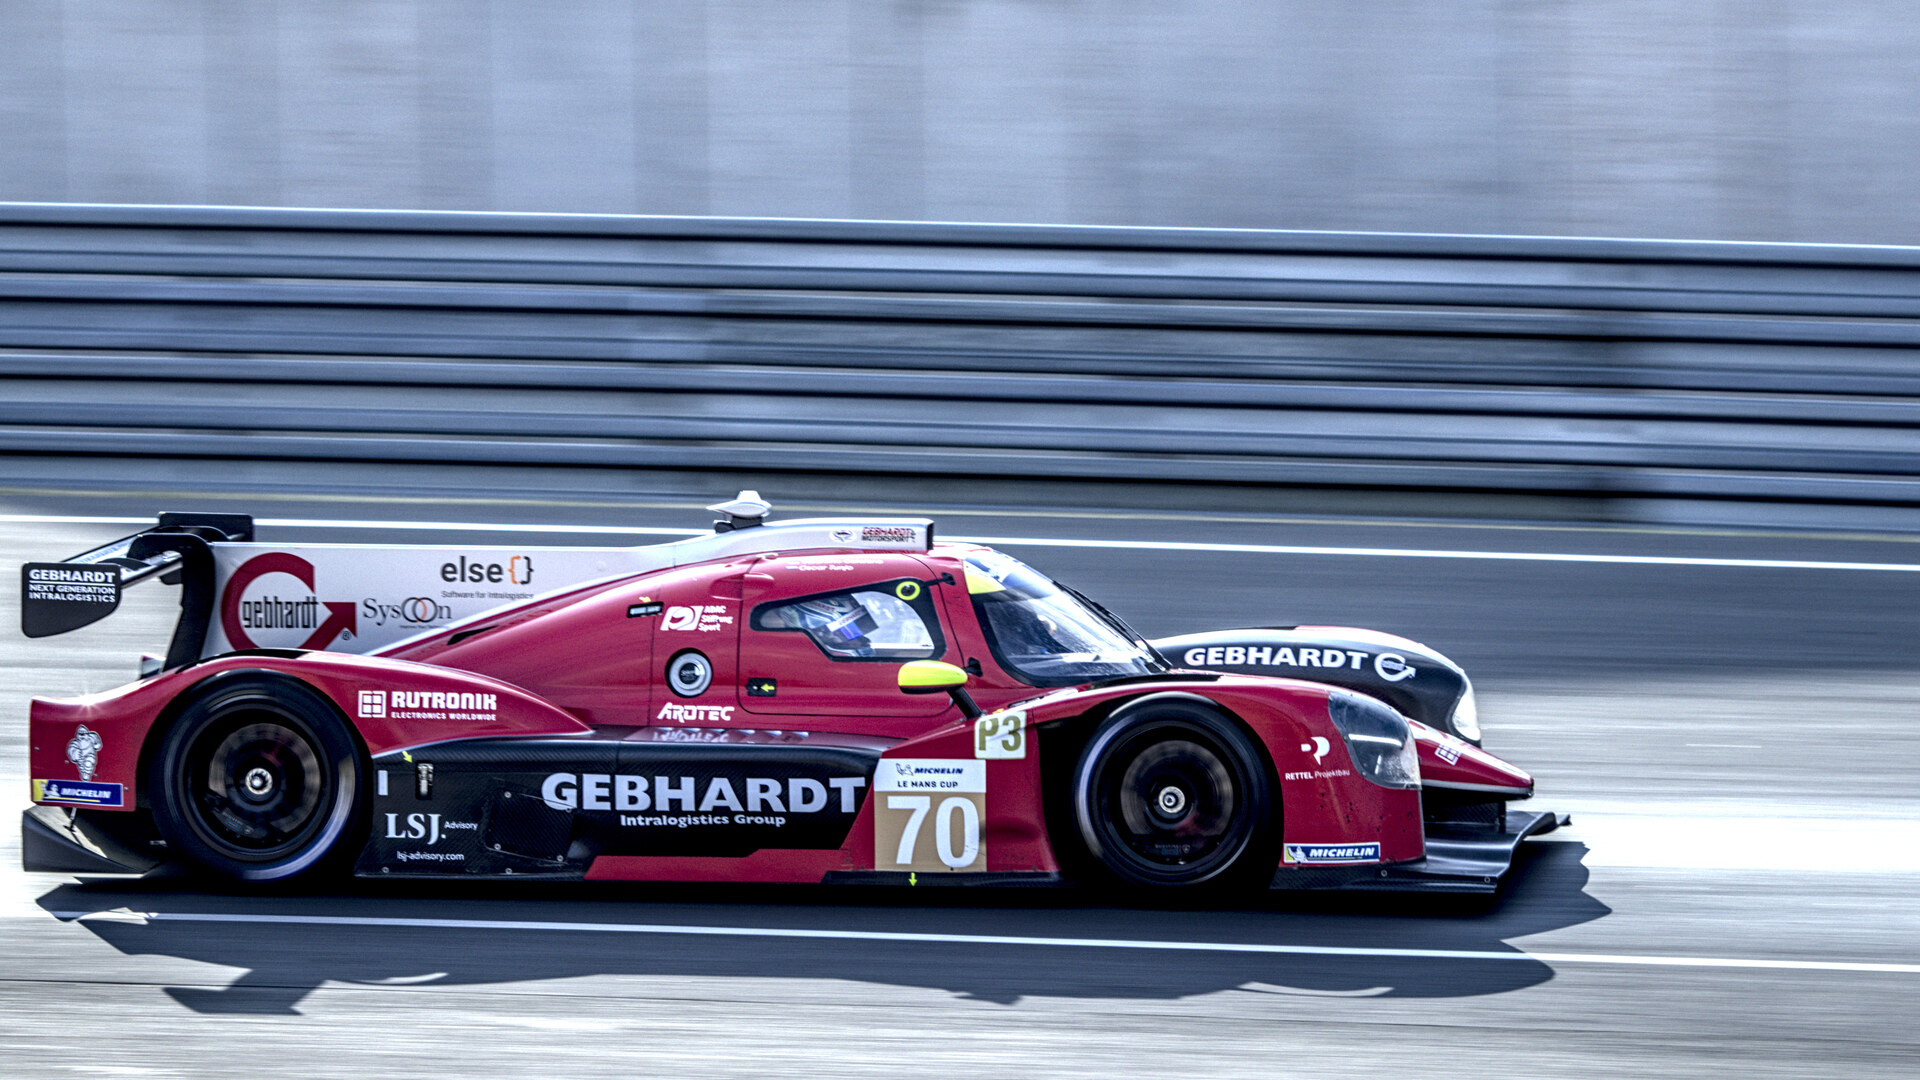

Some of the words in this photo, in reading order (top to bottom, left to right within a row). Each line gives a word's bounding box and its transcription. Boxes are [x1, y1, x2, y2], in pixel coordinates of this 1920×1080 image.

[29, 569, 116, 583] GEBHARDT
[29, 584, 55, 592] NEXT
[56, 585, 116, 594] GENERATION
[29, 592, 116, 602] INTRALOGISTICS
[243, 596, 318, 629] gebhardt
[698, 623, 720, 632] Sport
[1184, 646, 1368, 670] GEBHARDT
[391, 691, 497, 711] RUTRONIK
[391, 712, 446, 720] ELECTRONICS
[449, 713, 497, 721] WORLDWIDE
[657, 702, 735, 723] AROTEC
[978, 715, 1022, 752] P3
[914, 767, 963, 775] MICHELIN
[1285, 771, 1314, 781] RETTEL
[1314, 768, 1350, 780] Projektbau
[60, 787, 112, 799] MICHELIN
[541, 773, 866, 813] GEBHARDT
[444, 821, 478, 831] Advisory
[620, 814, 730, 829] Intralogistics
[734, 814, 786, 828] Group
[887, 795, 980, 868] 70
[397, 850, 465, 862] lsj-advisory.com
[1309, 847, 1375, 858] MICHELIN
